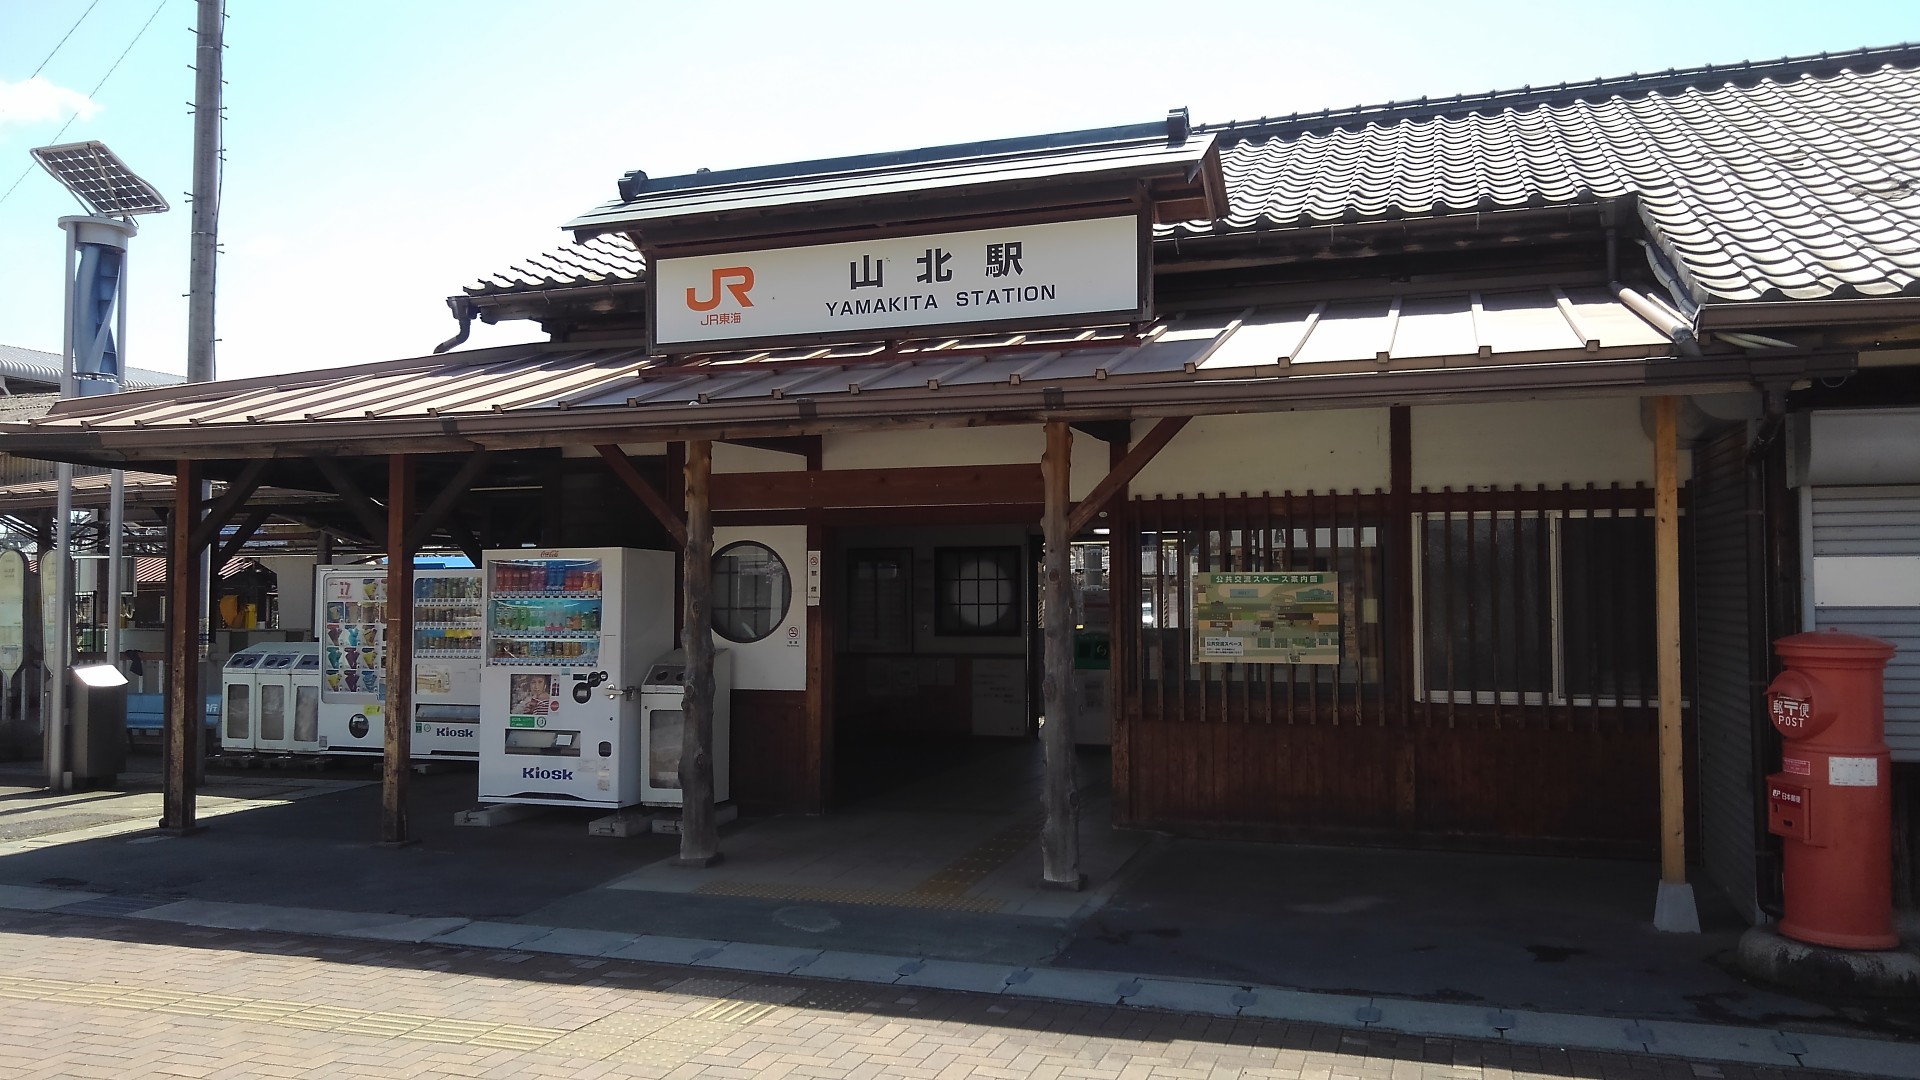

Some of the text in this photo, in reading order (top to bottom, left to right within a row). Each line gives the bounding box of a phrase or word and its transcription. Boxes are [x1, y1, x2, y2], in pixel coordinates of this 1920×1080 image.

[849, 241, 1024, 290] 山北駅
[686, 266, 755, 312] JR
[825, 284, 1057, 317] YAMAKITA STATION
[700, 312, 742, 326] JR東海
[1778, 715, 1805, 728] POST
[436, 726, 474, 738] Kiosk
[522, 766, 573, 781] Kiosk
